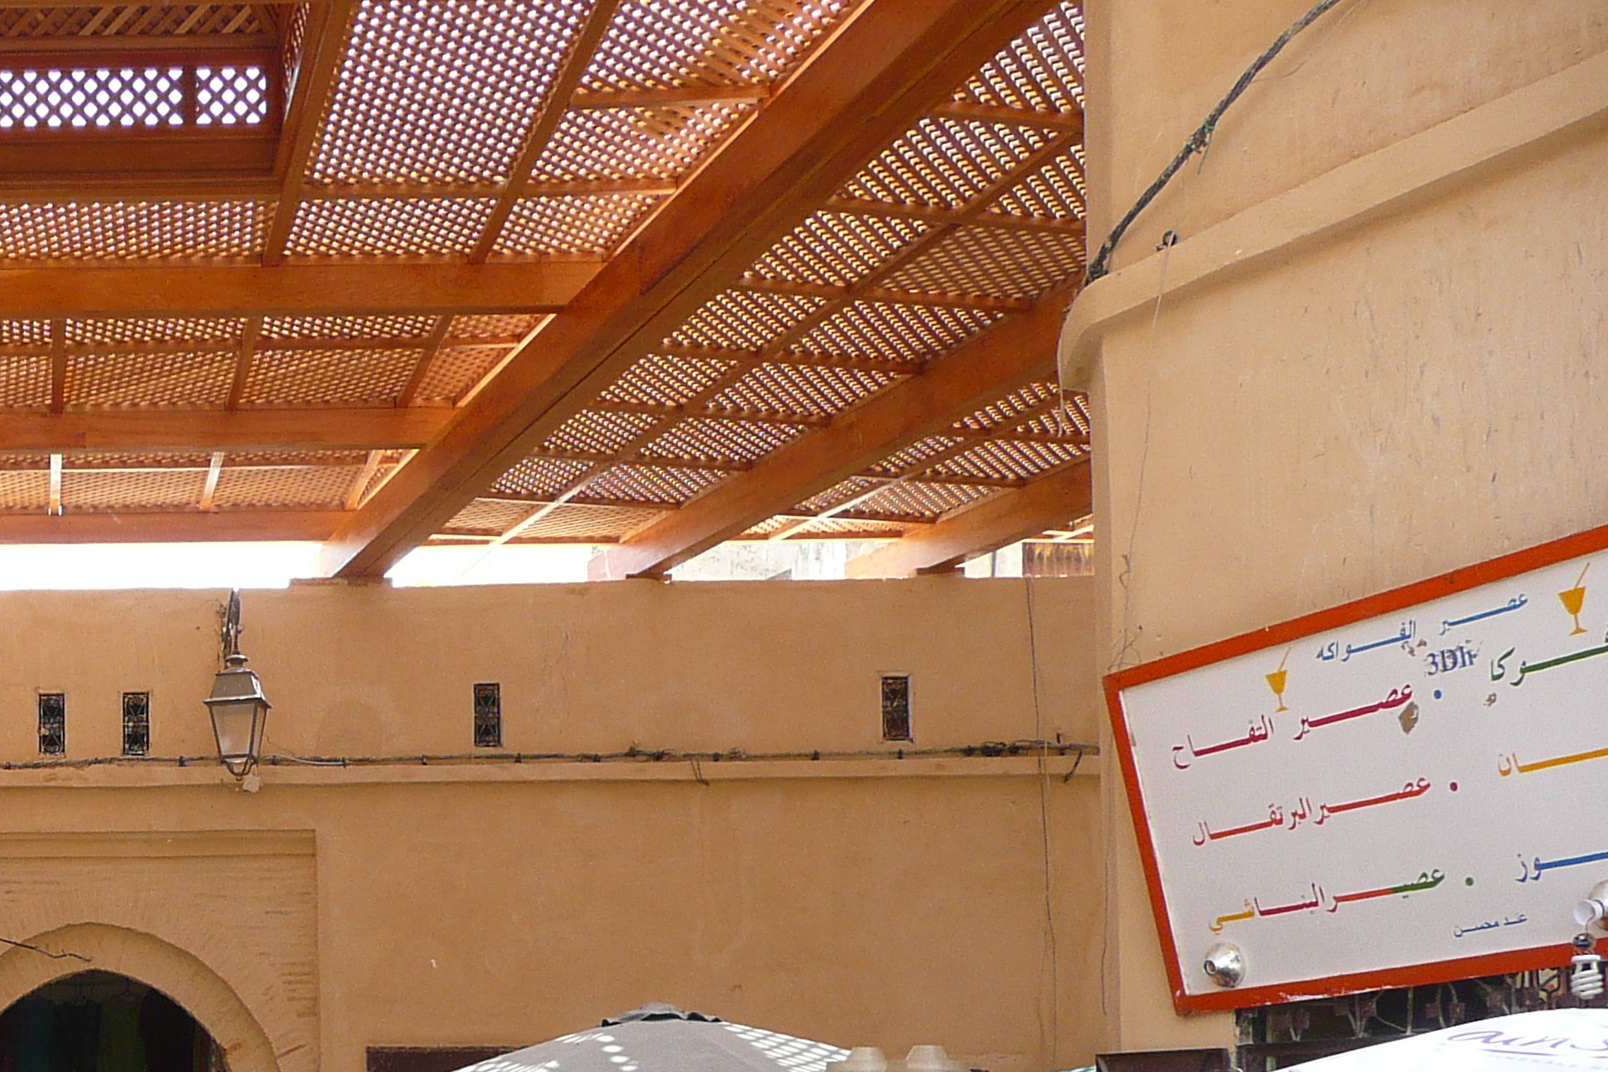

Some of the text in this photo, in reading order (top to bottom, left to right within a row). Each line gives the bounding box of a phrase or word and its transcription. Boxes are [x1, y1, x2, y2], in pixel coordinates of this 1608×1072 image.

[1315, 593, 1529, 663] عصير الفواكه
[1171, 683, 1413, 770] عصير التفاح
[1192, 776, 1432, 847] عصير البرتقال
[1325, 867, 1446, 914] عصير
